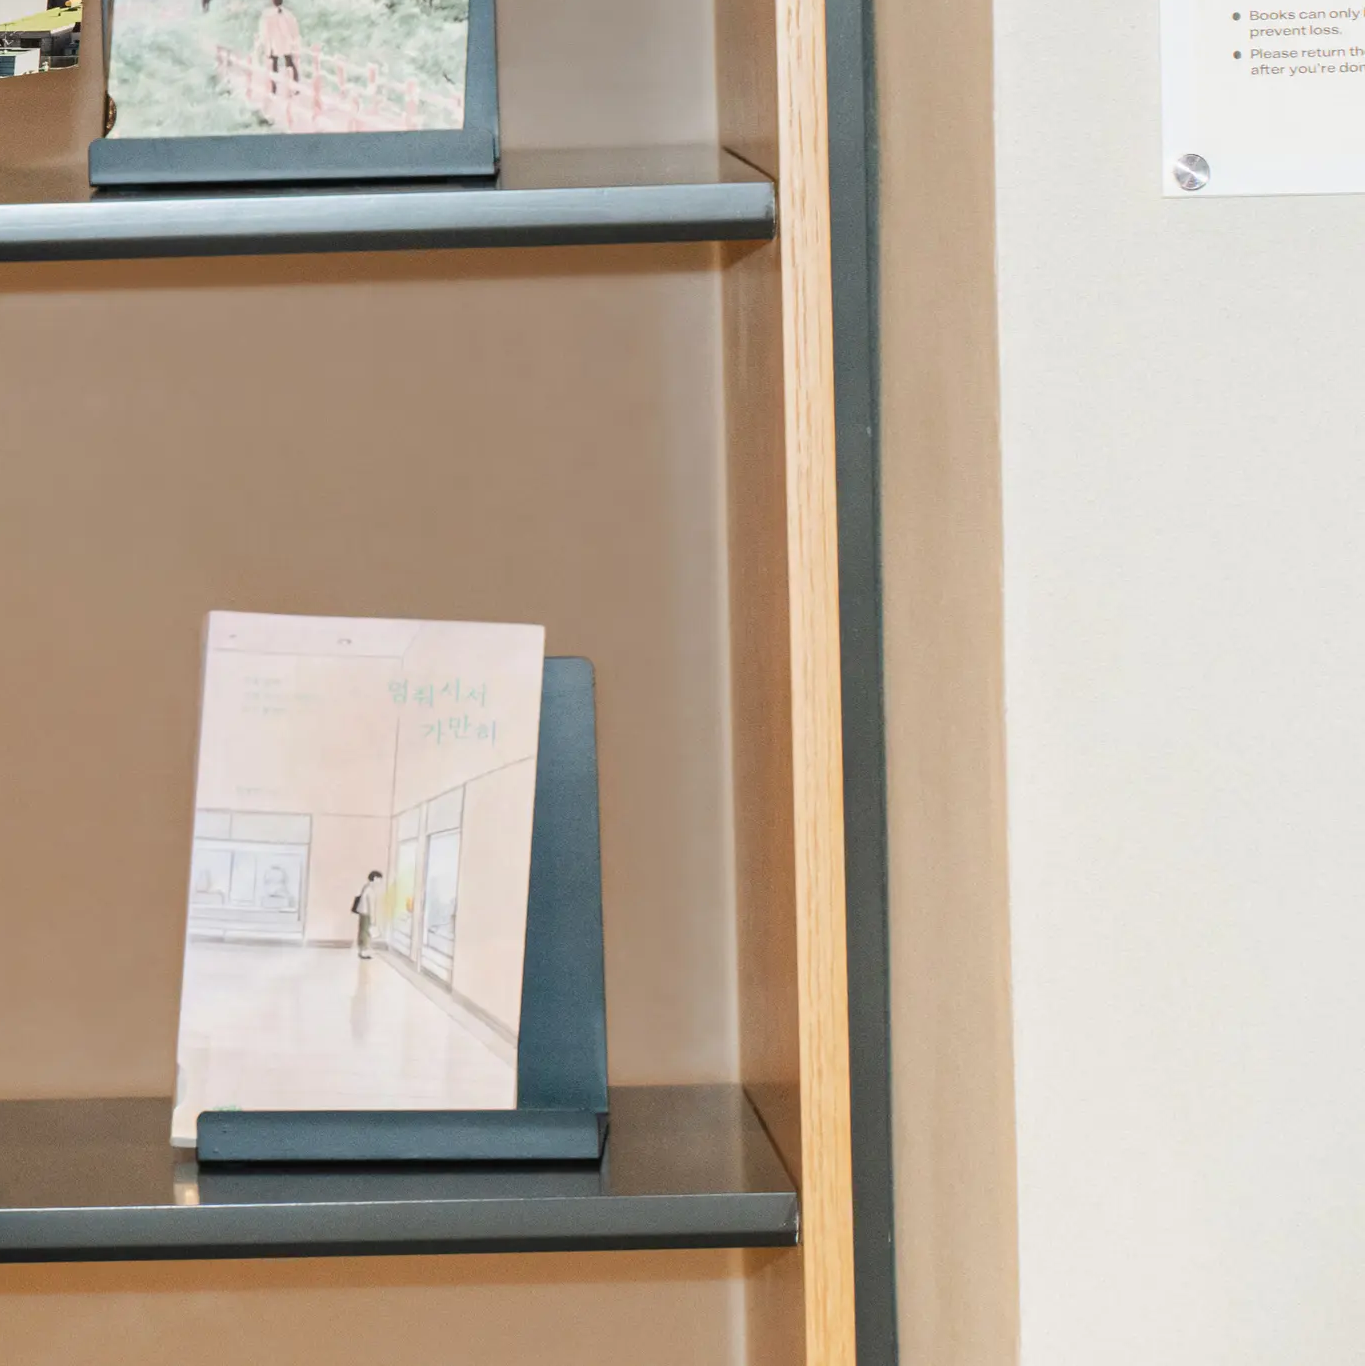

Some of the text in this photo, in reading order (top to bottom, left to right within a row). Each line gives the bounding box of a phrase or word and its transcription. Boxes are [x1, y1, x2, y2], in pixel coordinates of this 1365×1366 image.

[1249, 7, 1359, 22] Books can only
[1250, 24, 1343, 40] prevent loss.
[1250, 46, 1365, 60] Please return th
[1250, 63, 1285, 76] after
[1289, 63, 1336, 77] you're
